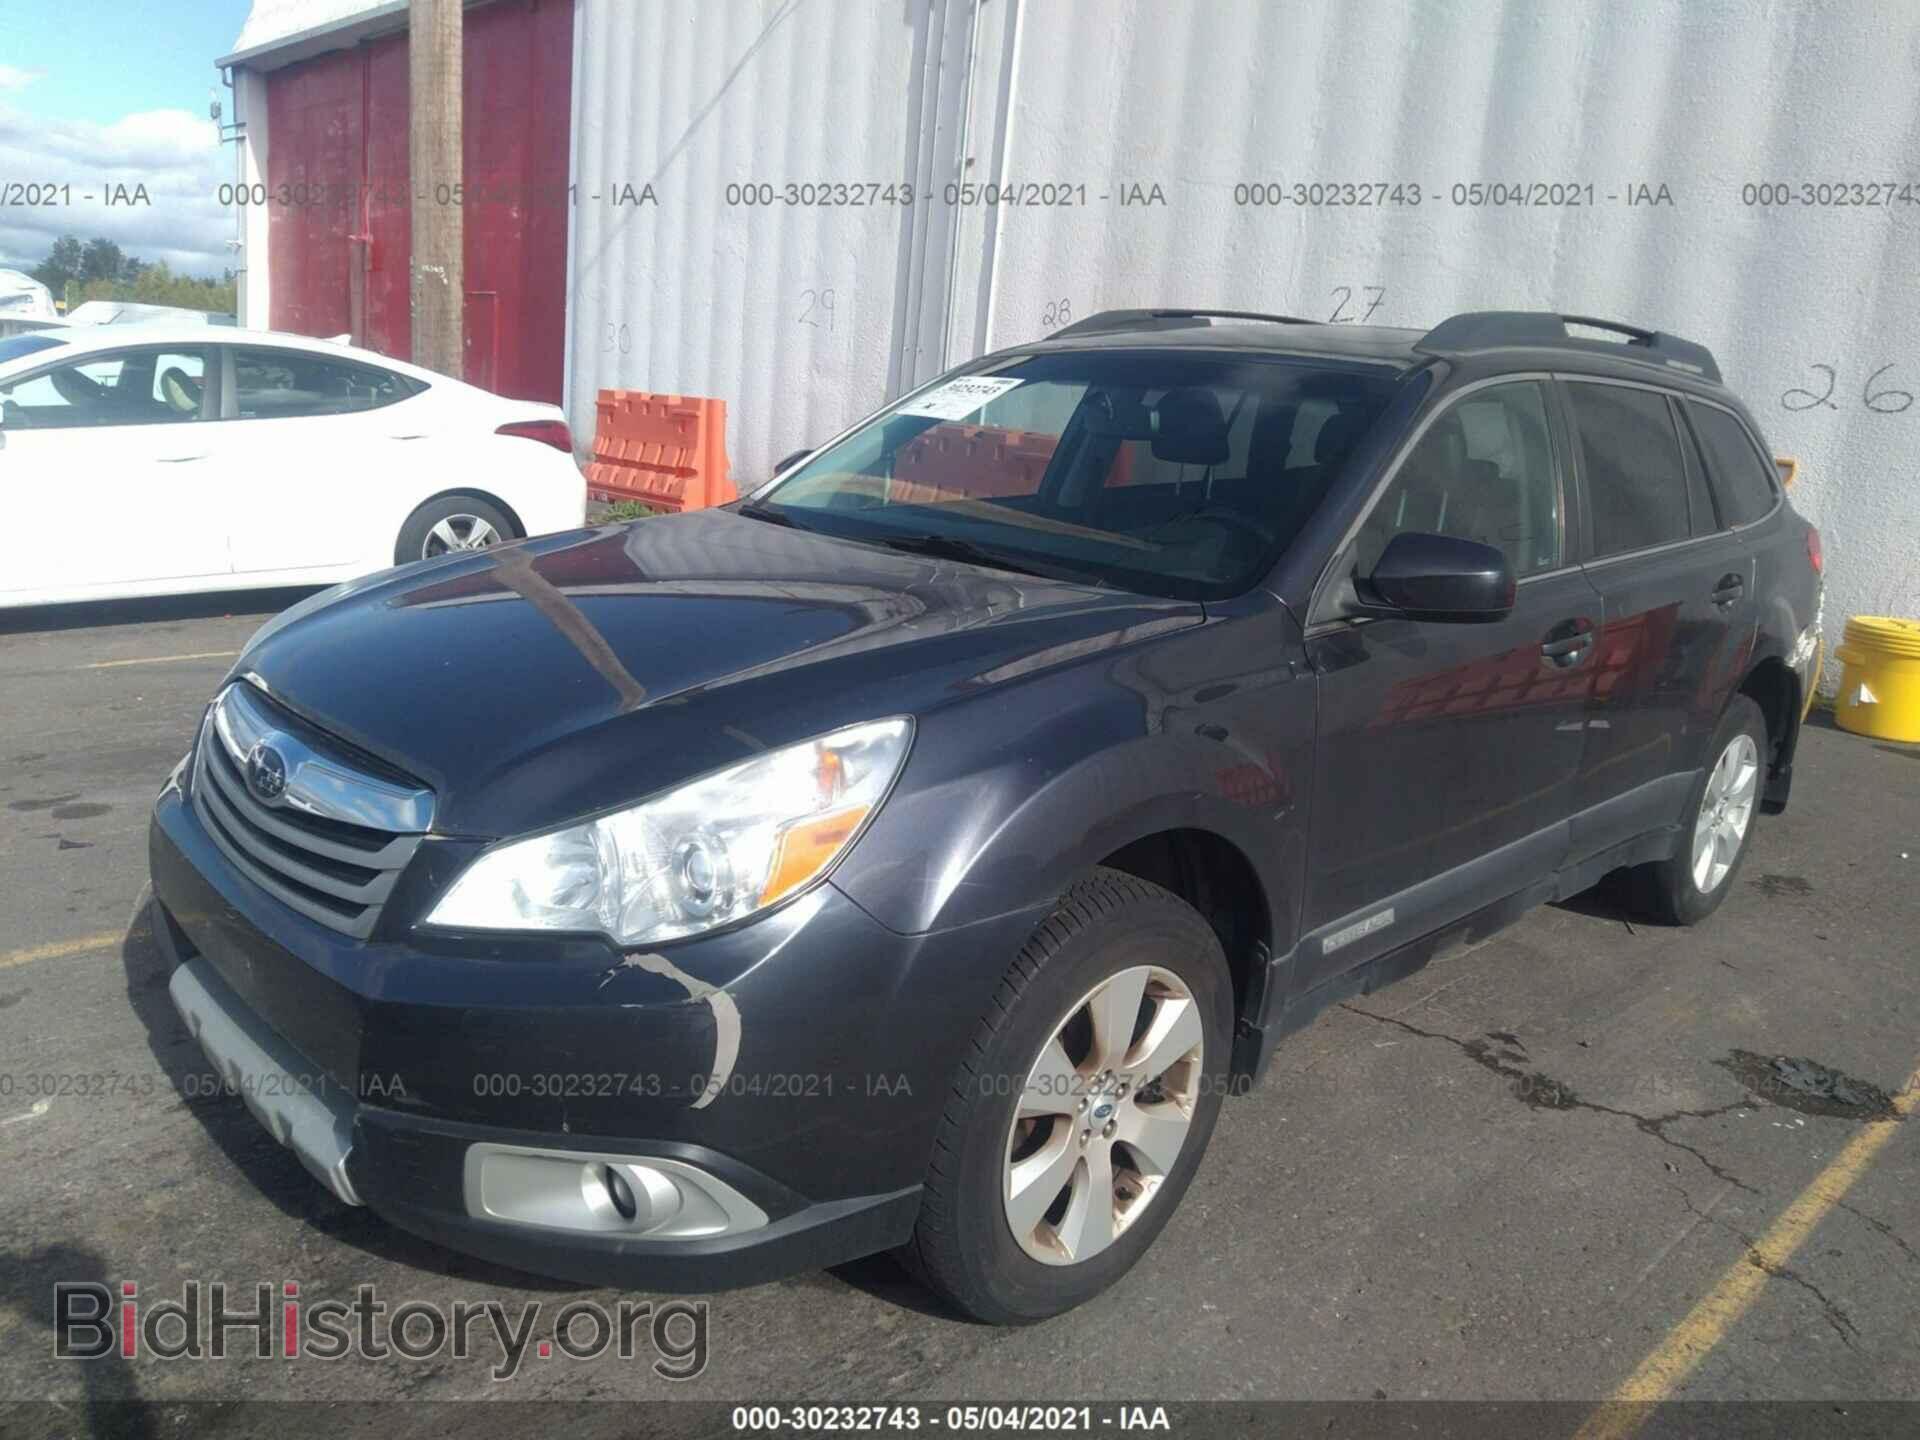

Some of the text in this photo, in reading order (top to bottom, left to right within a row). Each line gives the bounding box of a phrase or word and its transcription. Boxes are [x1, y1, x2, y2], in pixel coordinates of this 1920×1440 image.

[797, 288, 835, 331] 29
[1042, 298, 1072, 328] 28
[1328, 285, 1387, 323] 27
